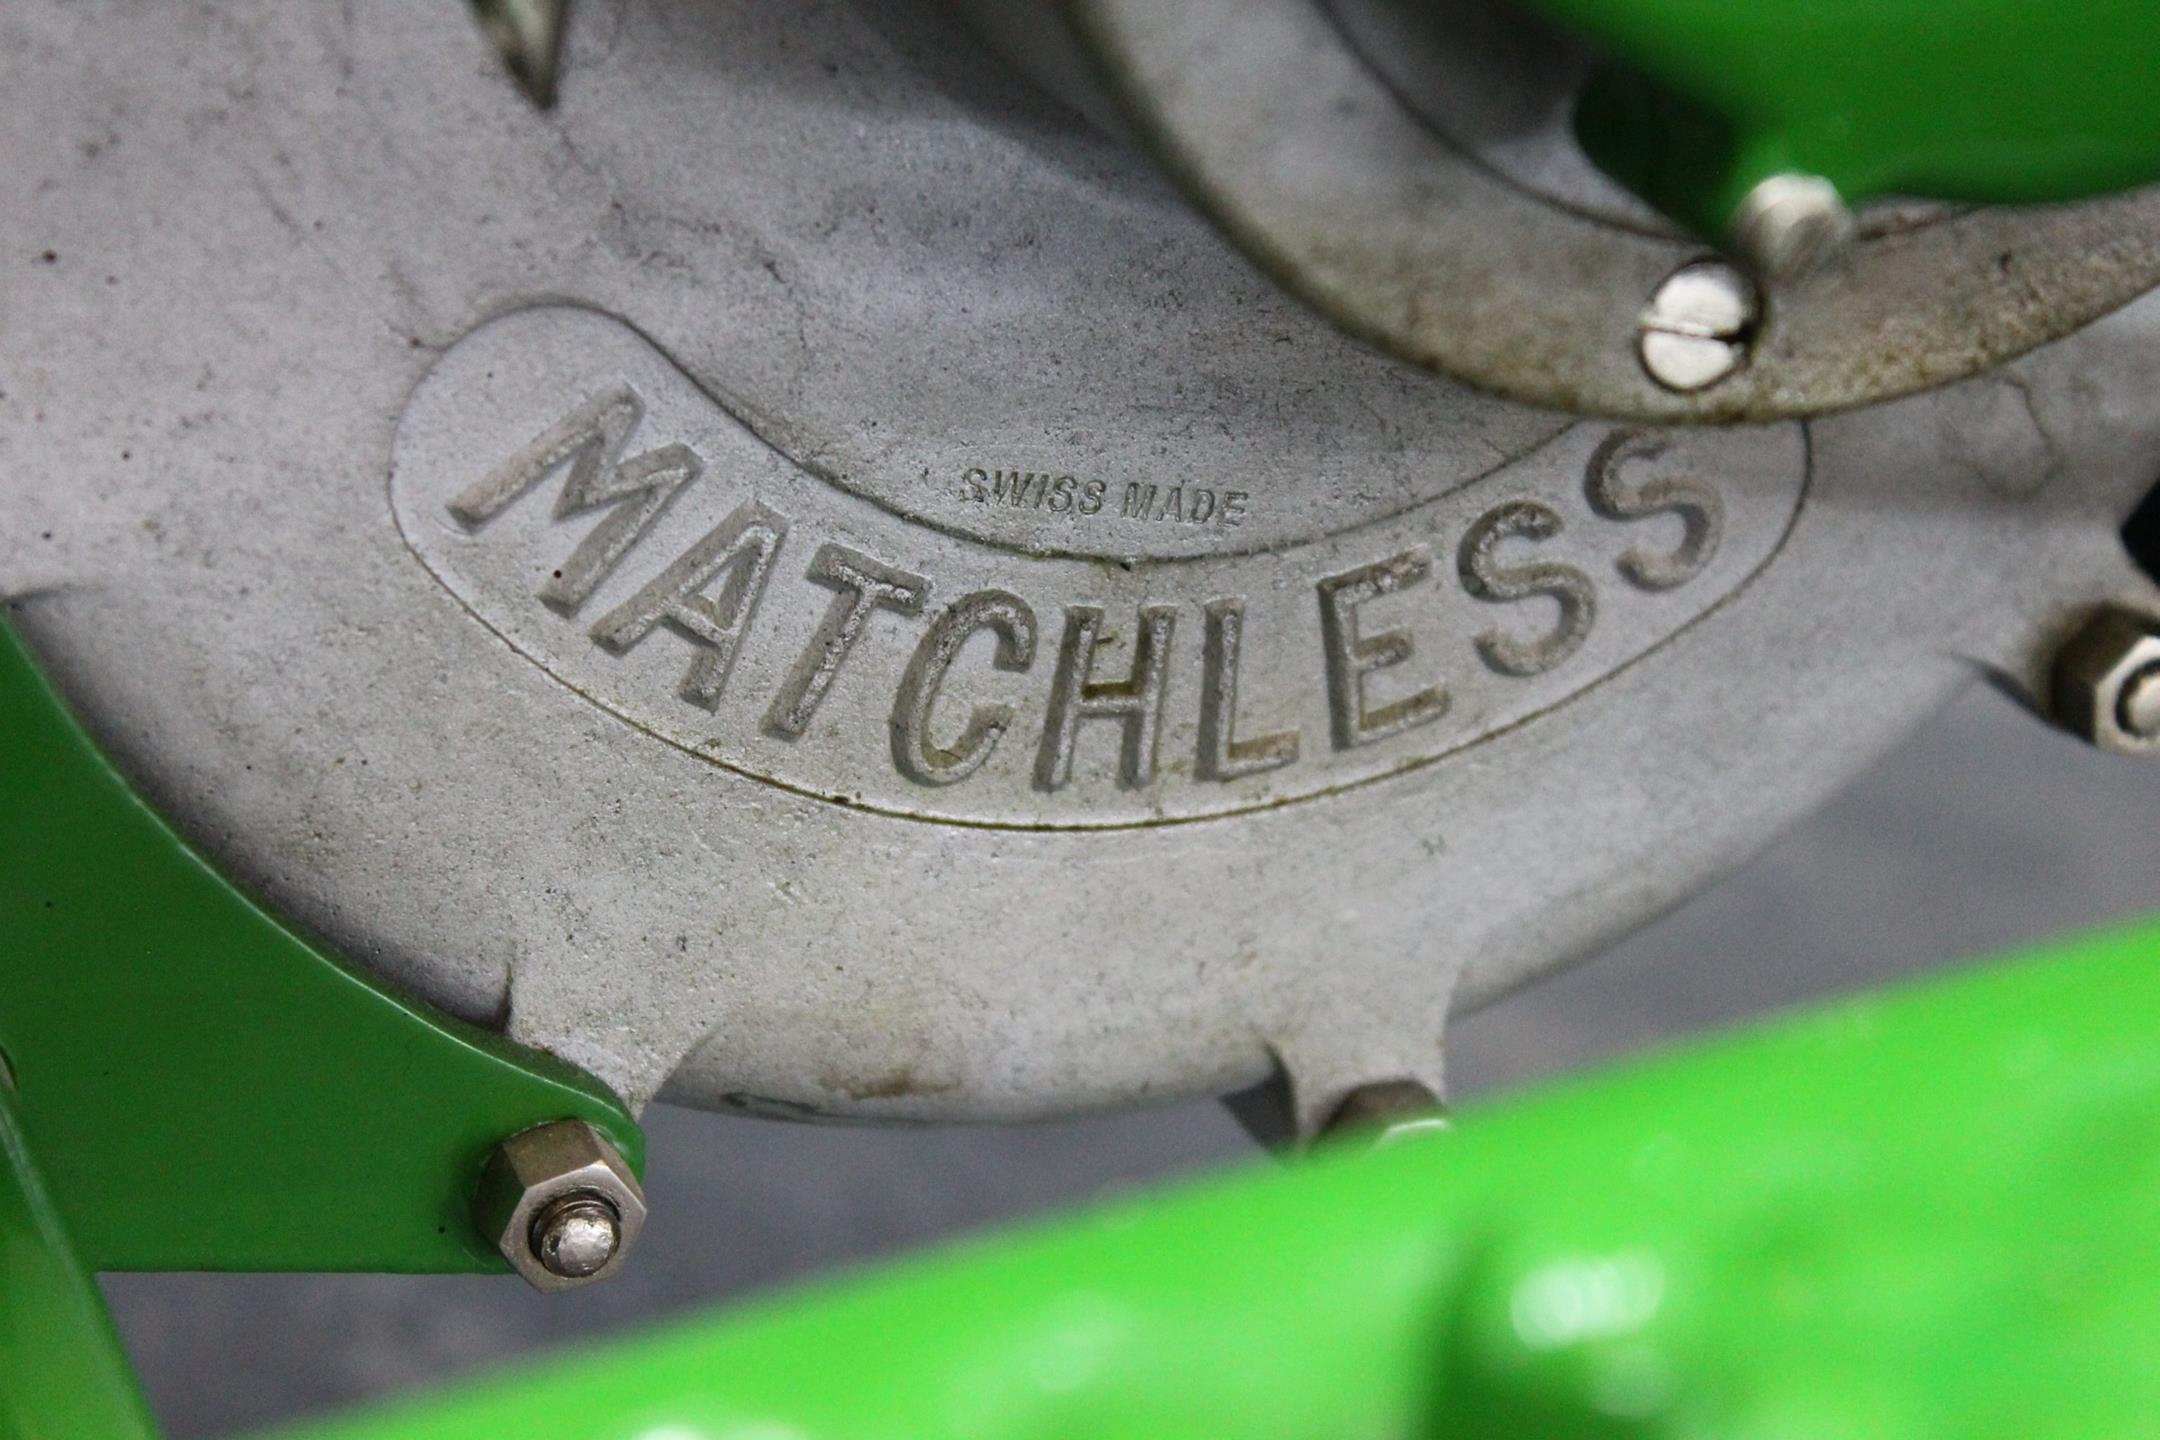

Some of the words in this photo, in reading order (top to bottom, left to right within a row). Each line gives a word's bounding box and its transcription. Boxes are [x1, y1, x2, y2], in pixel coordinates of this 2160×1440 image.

[445, 380, 1723, 791] MATCHLESS
[959, 468, 1106, 515] SWISS
[1120, 481, 1249, 527] MADE
